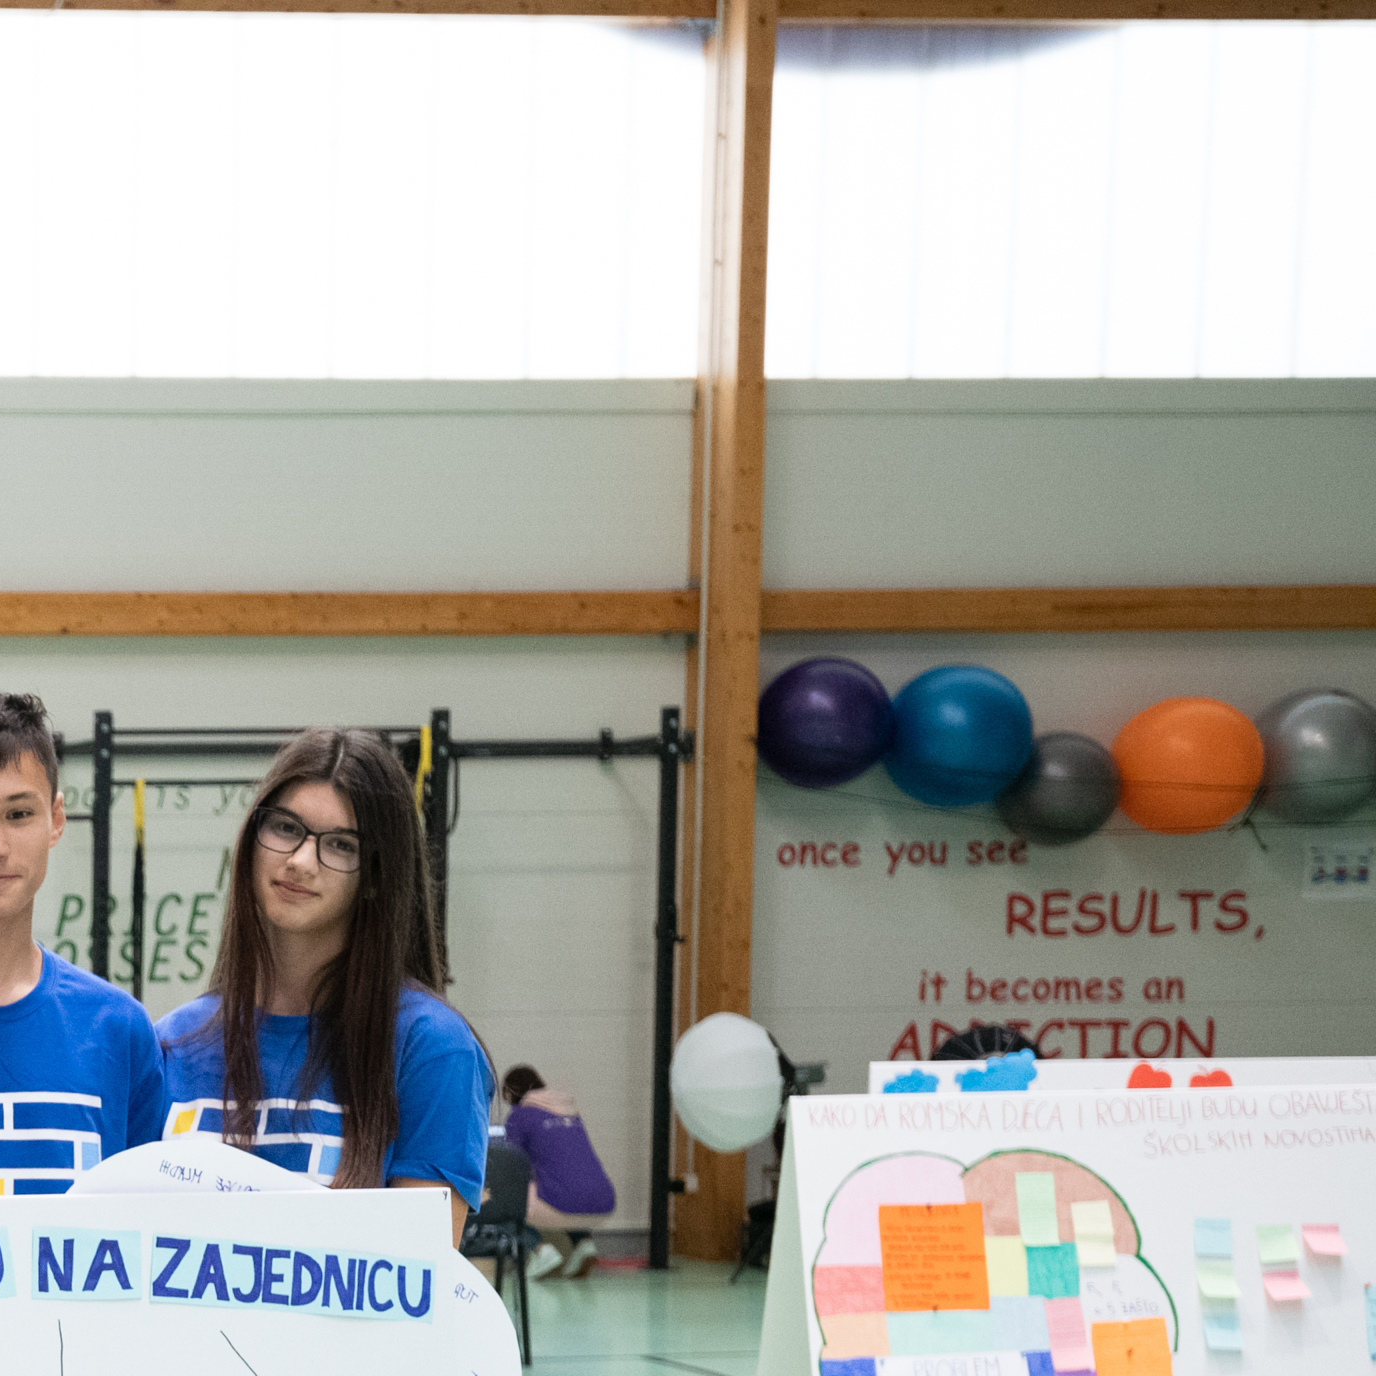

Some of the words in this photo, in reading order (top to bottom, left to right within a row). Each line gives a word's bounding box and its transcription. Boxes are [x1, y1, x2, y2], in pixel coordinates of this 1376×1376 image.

[777, 841, 861, 868] once
[885, 841, 948, 877] you
[967, 839, 1028, 866] see
[1006, 887, 1265, 940] RESULTS,
[919, 968, 947, 1002] it
[965, 967, 1124, 1003] becomes
[1143, 976, 1185, 1002] an
[808, 1103, 856, 1129] KAKO
[865, 1103, 888, 1129] DA
[899, 1100, 992, 1131] ROMSKA
[1002, 1099, 1063, 1132] DJECA
[1096, 1095, 1192, 1128] RODITELJI
[1202, 1096, 1257, 1119] BUDU
[38, 1236, 133, 1293] NA
[152, 1236, 431, 1318] ZAJEDNICU
